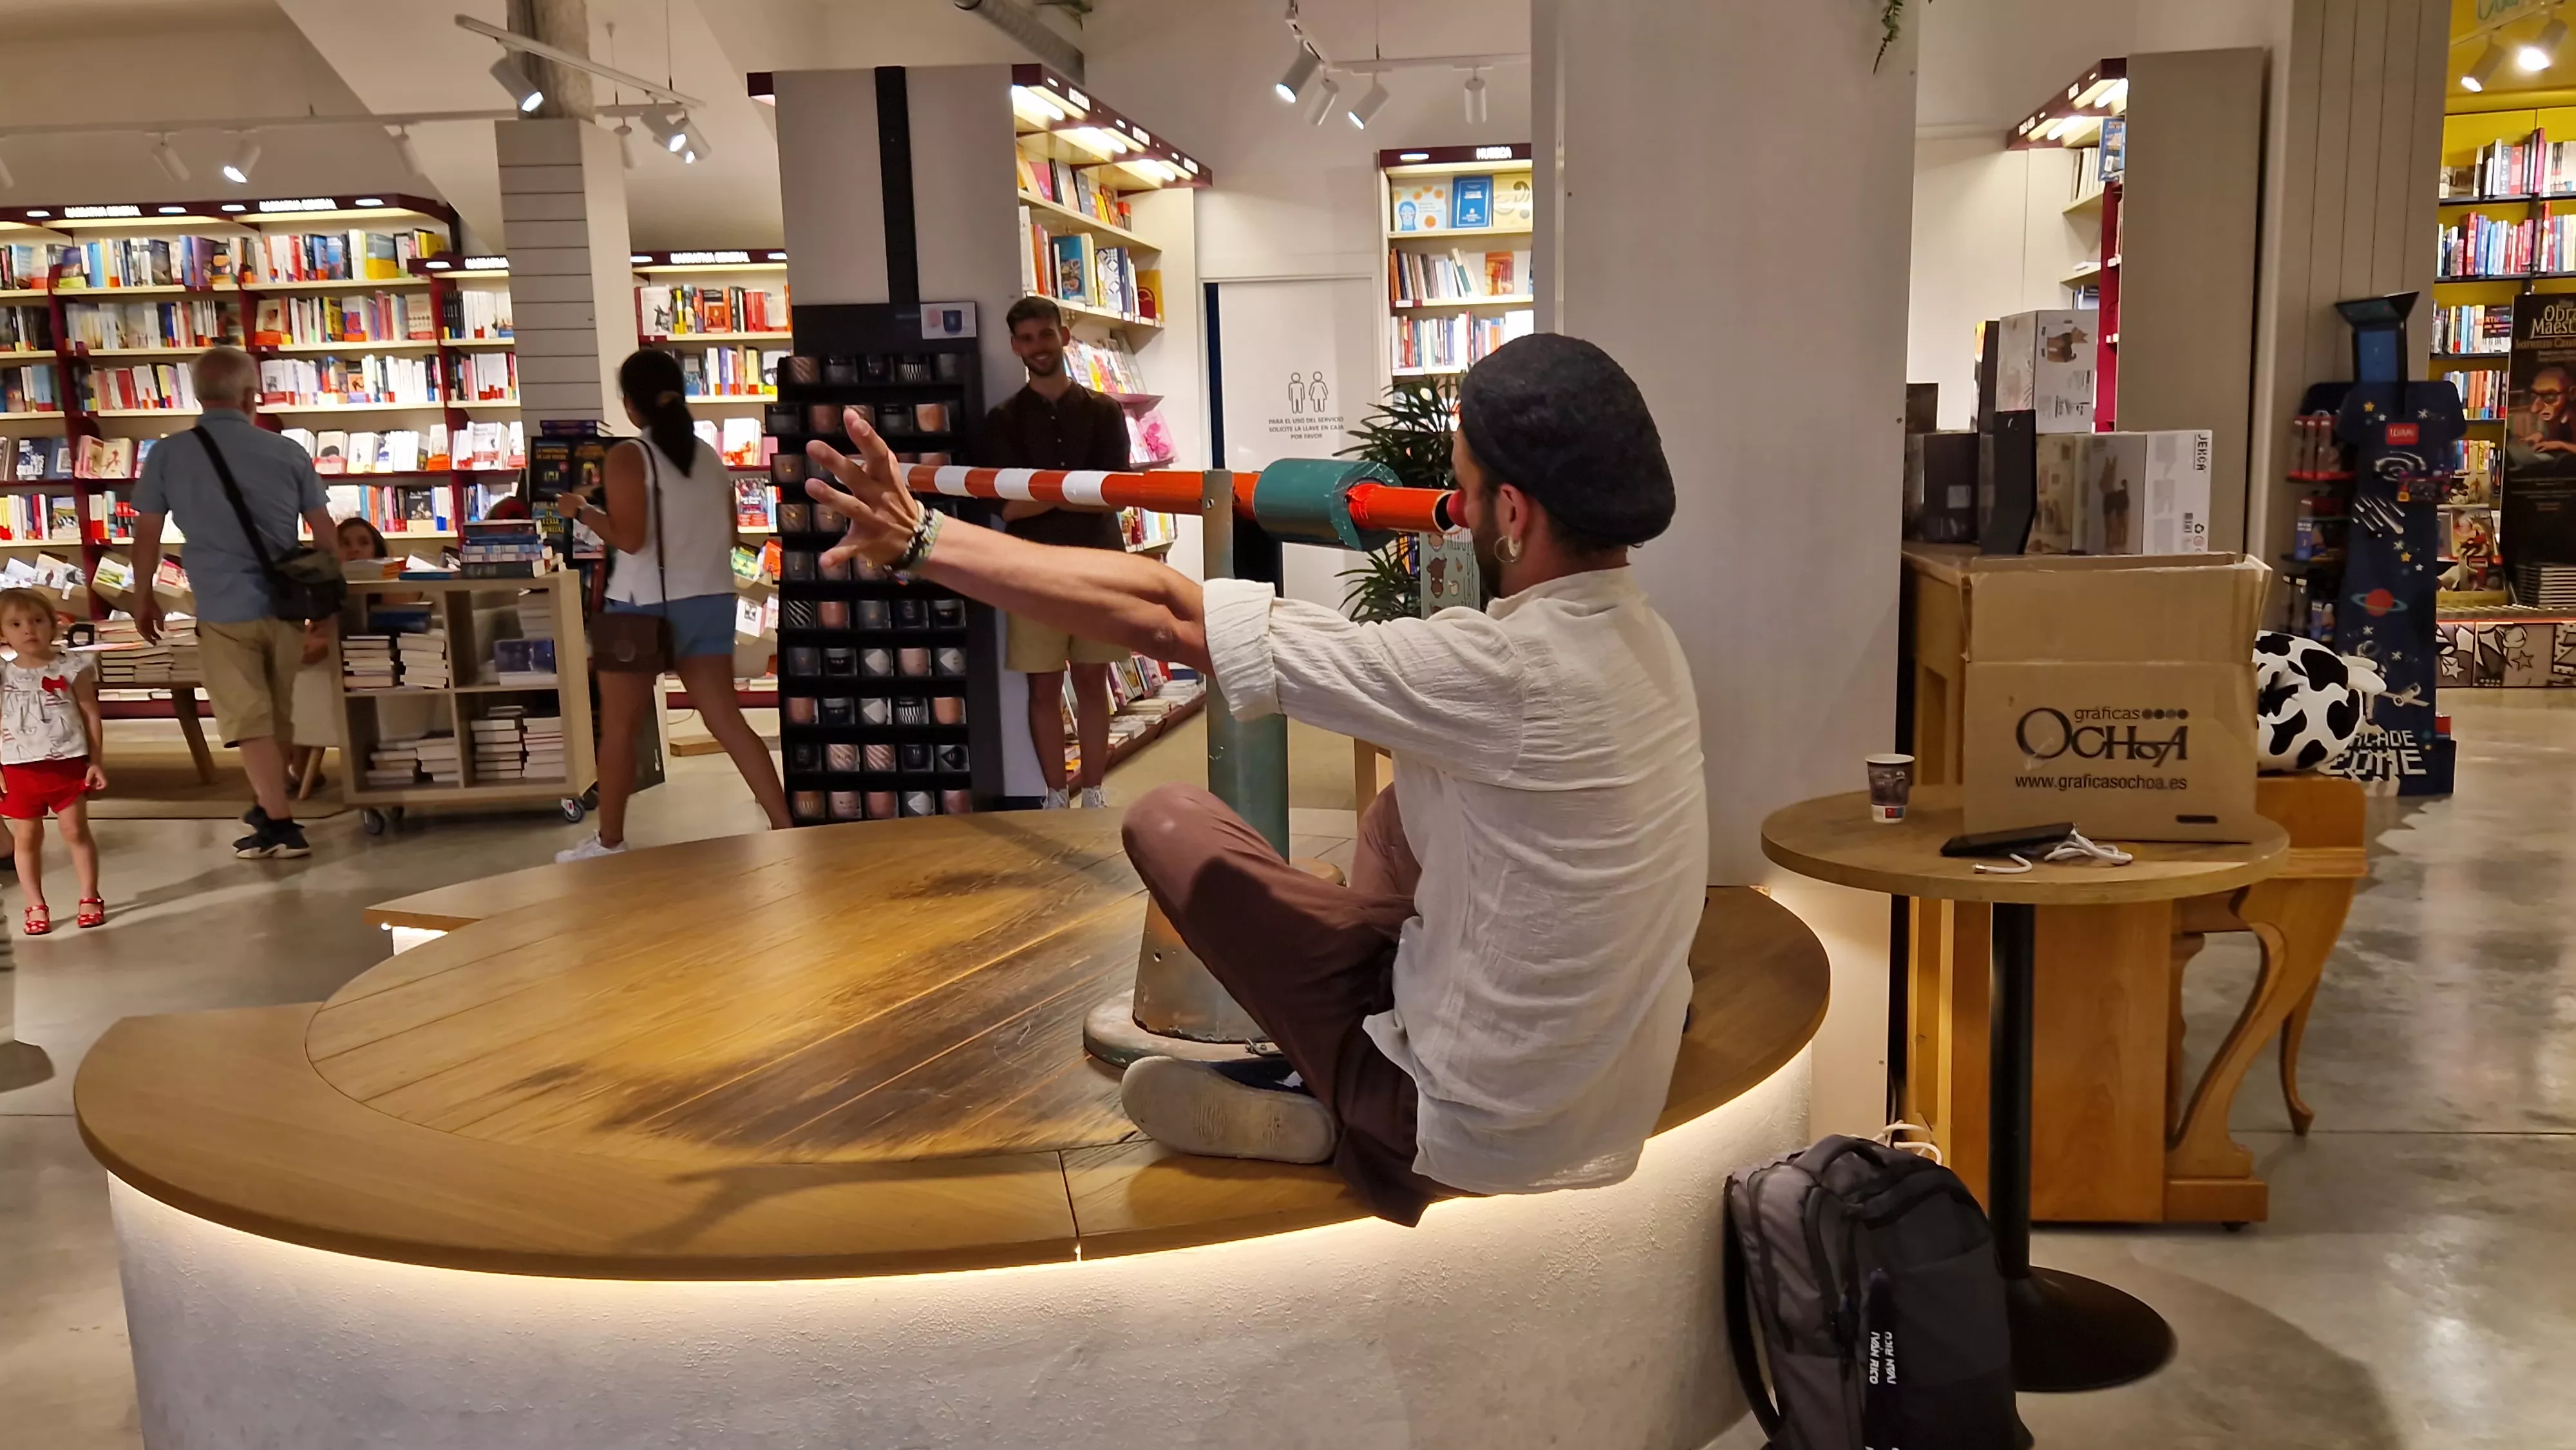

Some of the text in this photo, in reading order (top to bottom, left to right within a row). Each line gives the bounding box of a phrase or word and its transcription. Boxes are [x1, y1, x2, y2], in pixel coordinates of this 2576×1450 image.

[1476, 146, 1512, 160] HUESCA
[2197, 434, 2208, 471] JEKCA
[2074, 707, 2140, 722] gráficas
[2015, 773, 2187, 791] www.graficasochoa.es
[1884, 1332, 1895, 1357] RICO
[1870, 1359, 1879, 1384] RICO
